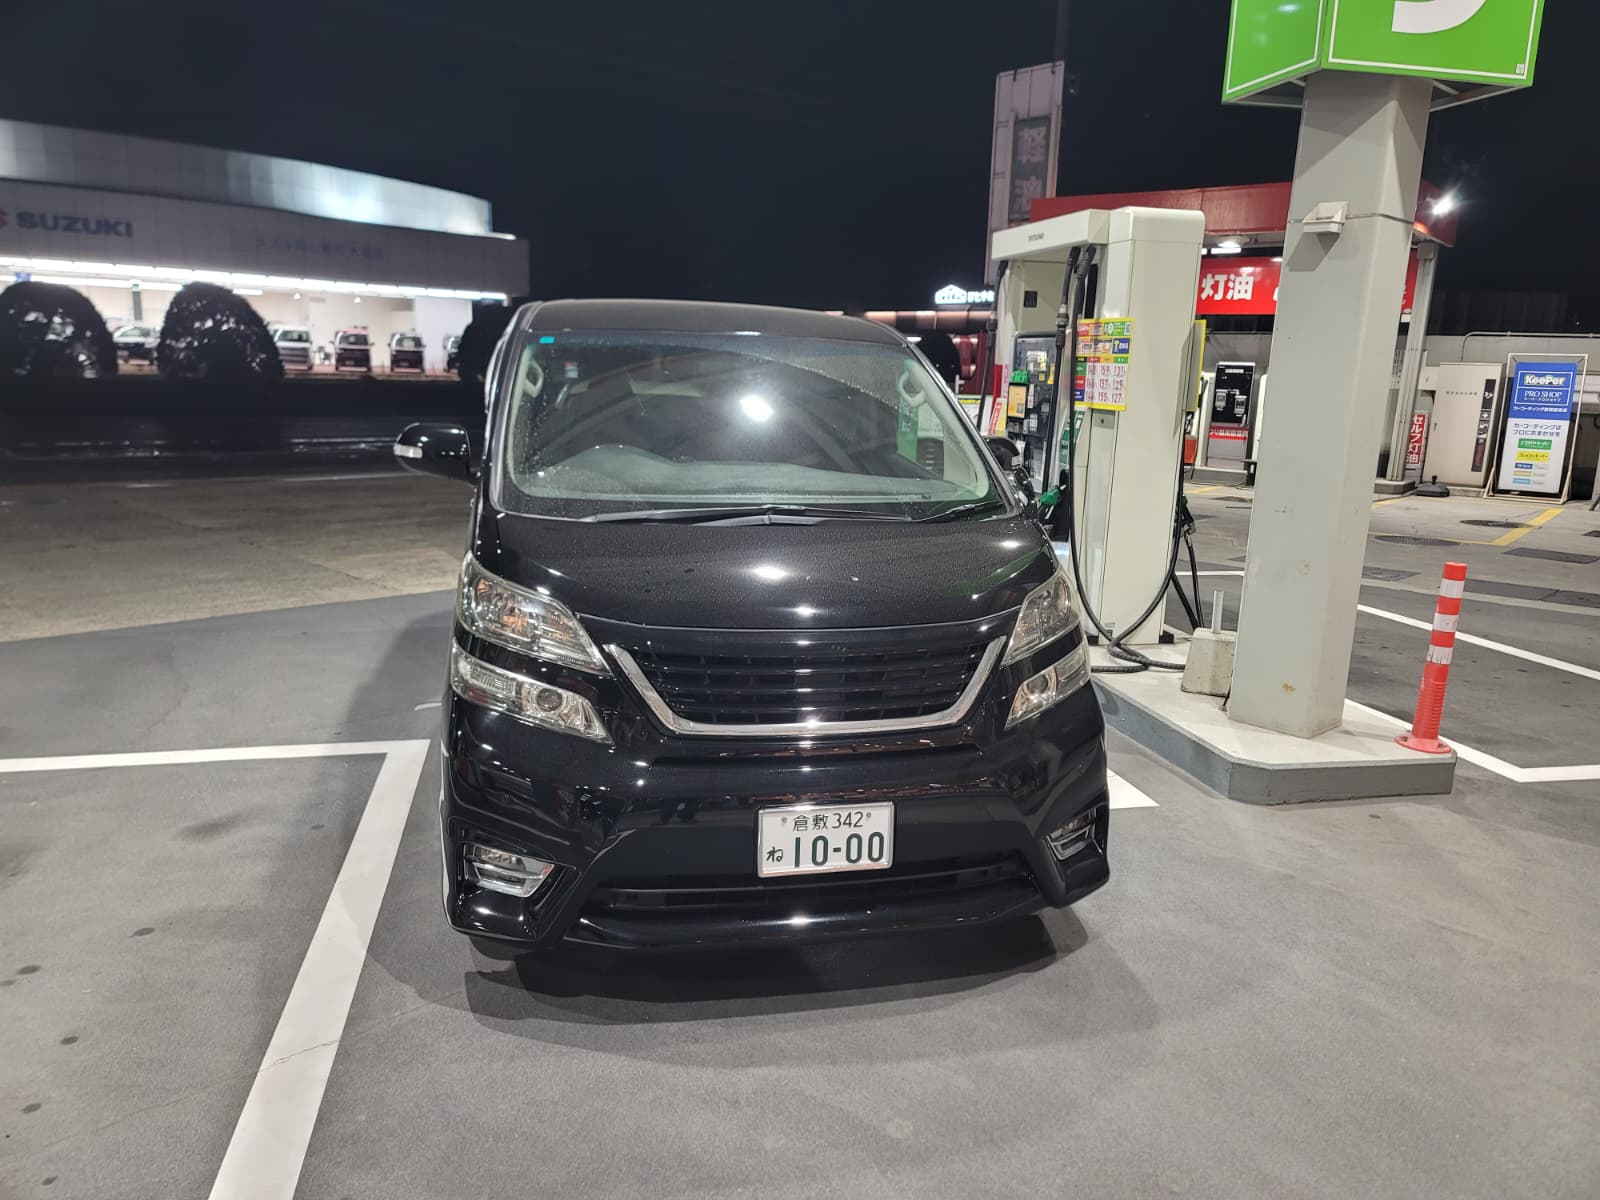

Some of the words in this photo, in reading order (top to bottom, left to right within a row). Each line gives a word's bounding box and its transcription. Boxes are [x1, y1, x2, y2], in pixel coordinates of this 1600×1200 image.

[16, 211, 133, 238] SUZUKI
[1200, 272, 1255, 301] 灯油
[1523, 374, 1567, 386] KeePer
[1524, 390, 1541, 398] PRO
[1406, 414, 1426, 464] セルフ灯油
[766, 846, 784, 863] ね
[794, 831, 885, 868] 10-00
